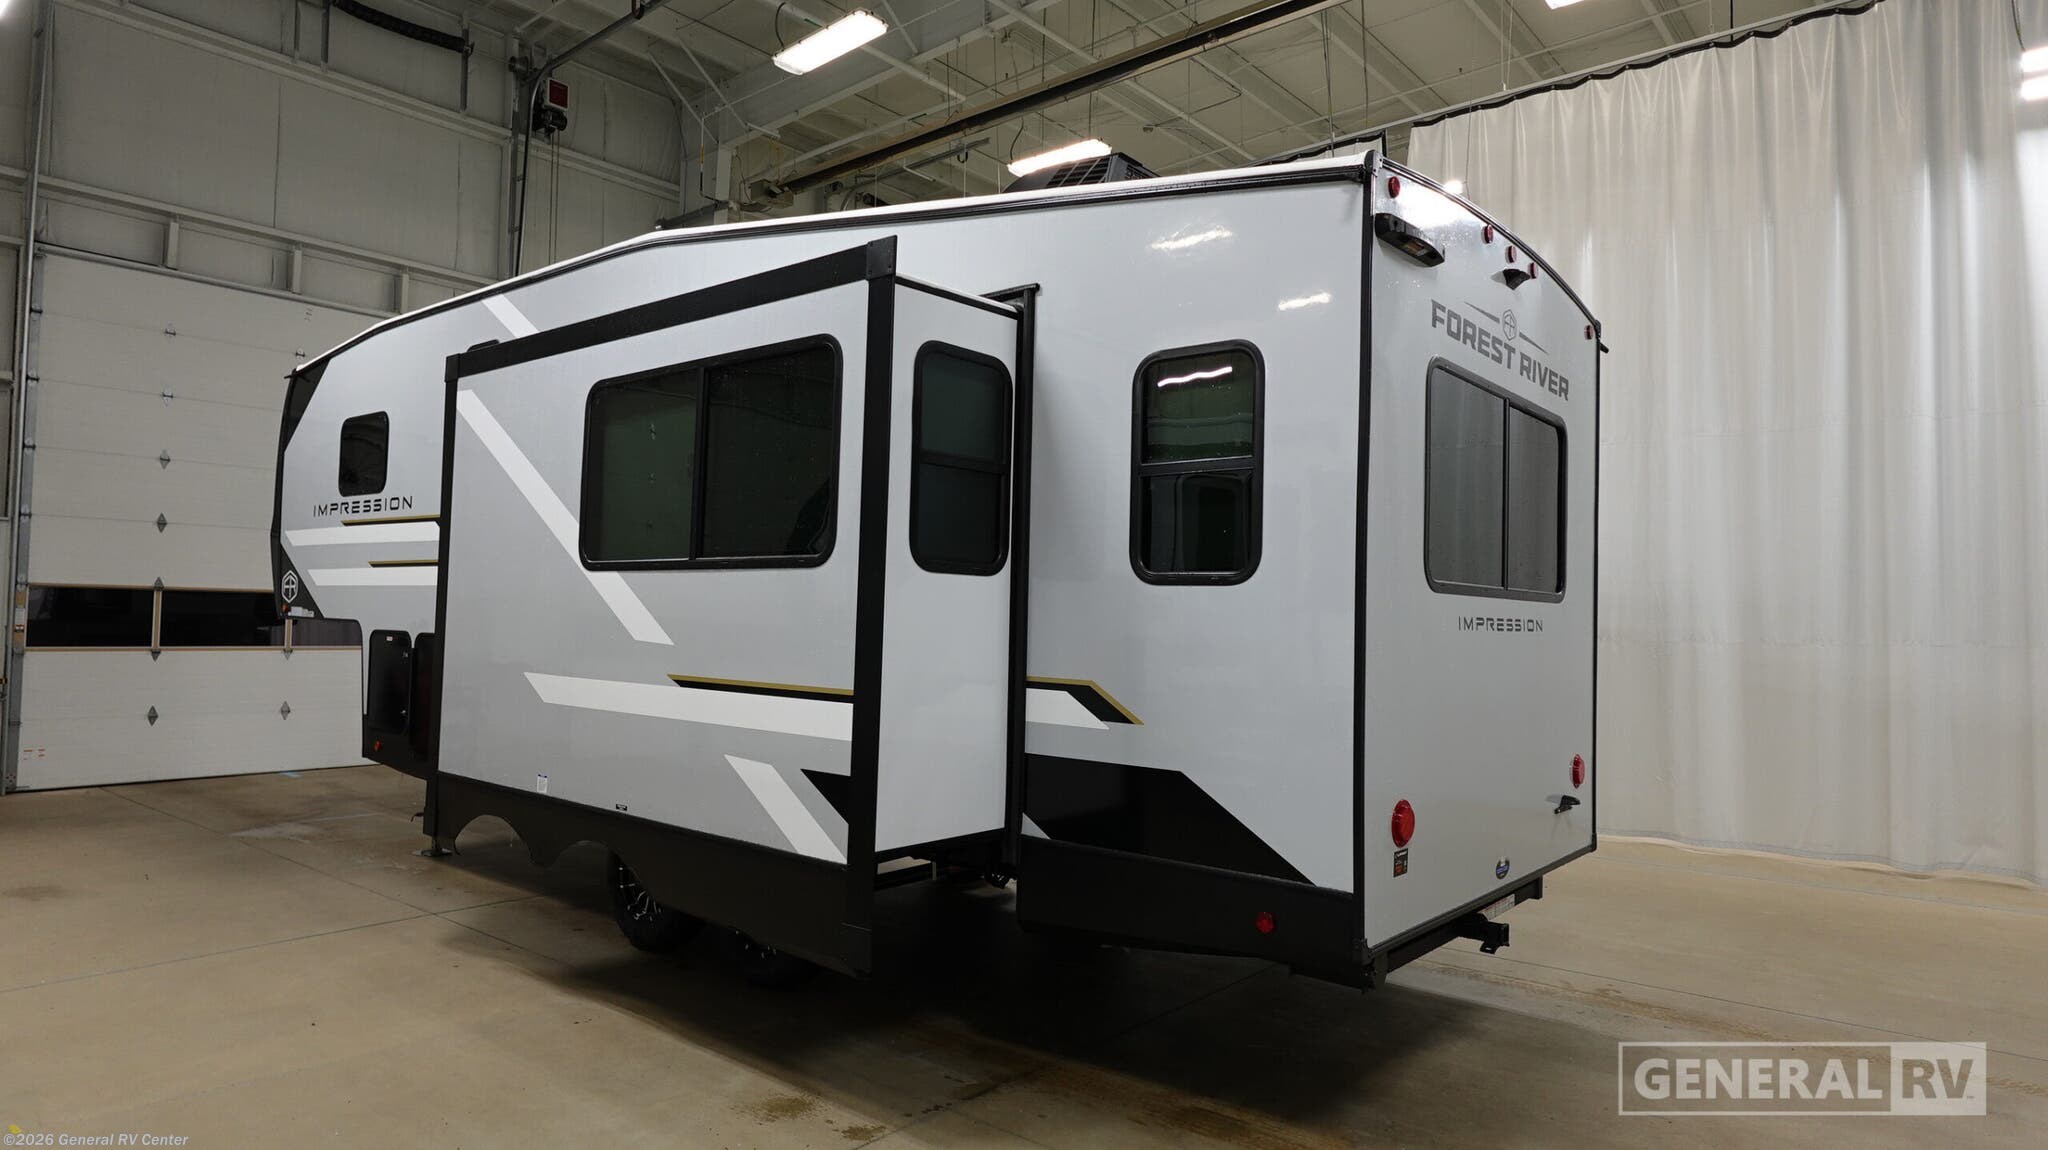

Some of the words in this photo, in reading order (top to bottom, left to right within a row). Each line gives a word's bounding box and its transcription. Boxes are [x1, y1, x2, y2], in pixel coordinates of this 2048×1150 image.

[1431, 298, 1516, 370] FOREST
[1519, 351, 1569, 401] RIVER
[313, 496, 413, 517] IMPRESSION
[1458, 616, 1543, 632] IMPRESSION
